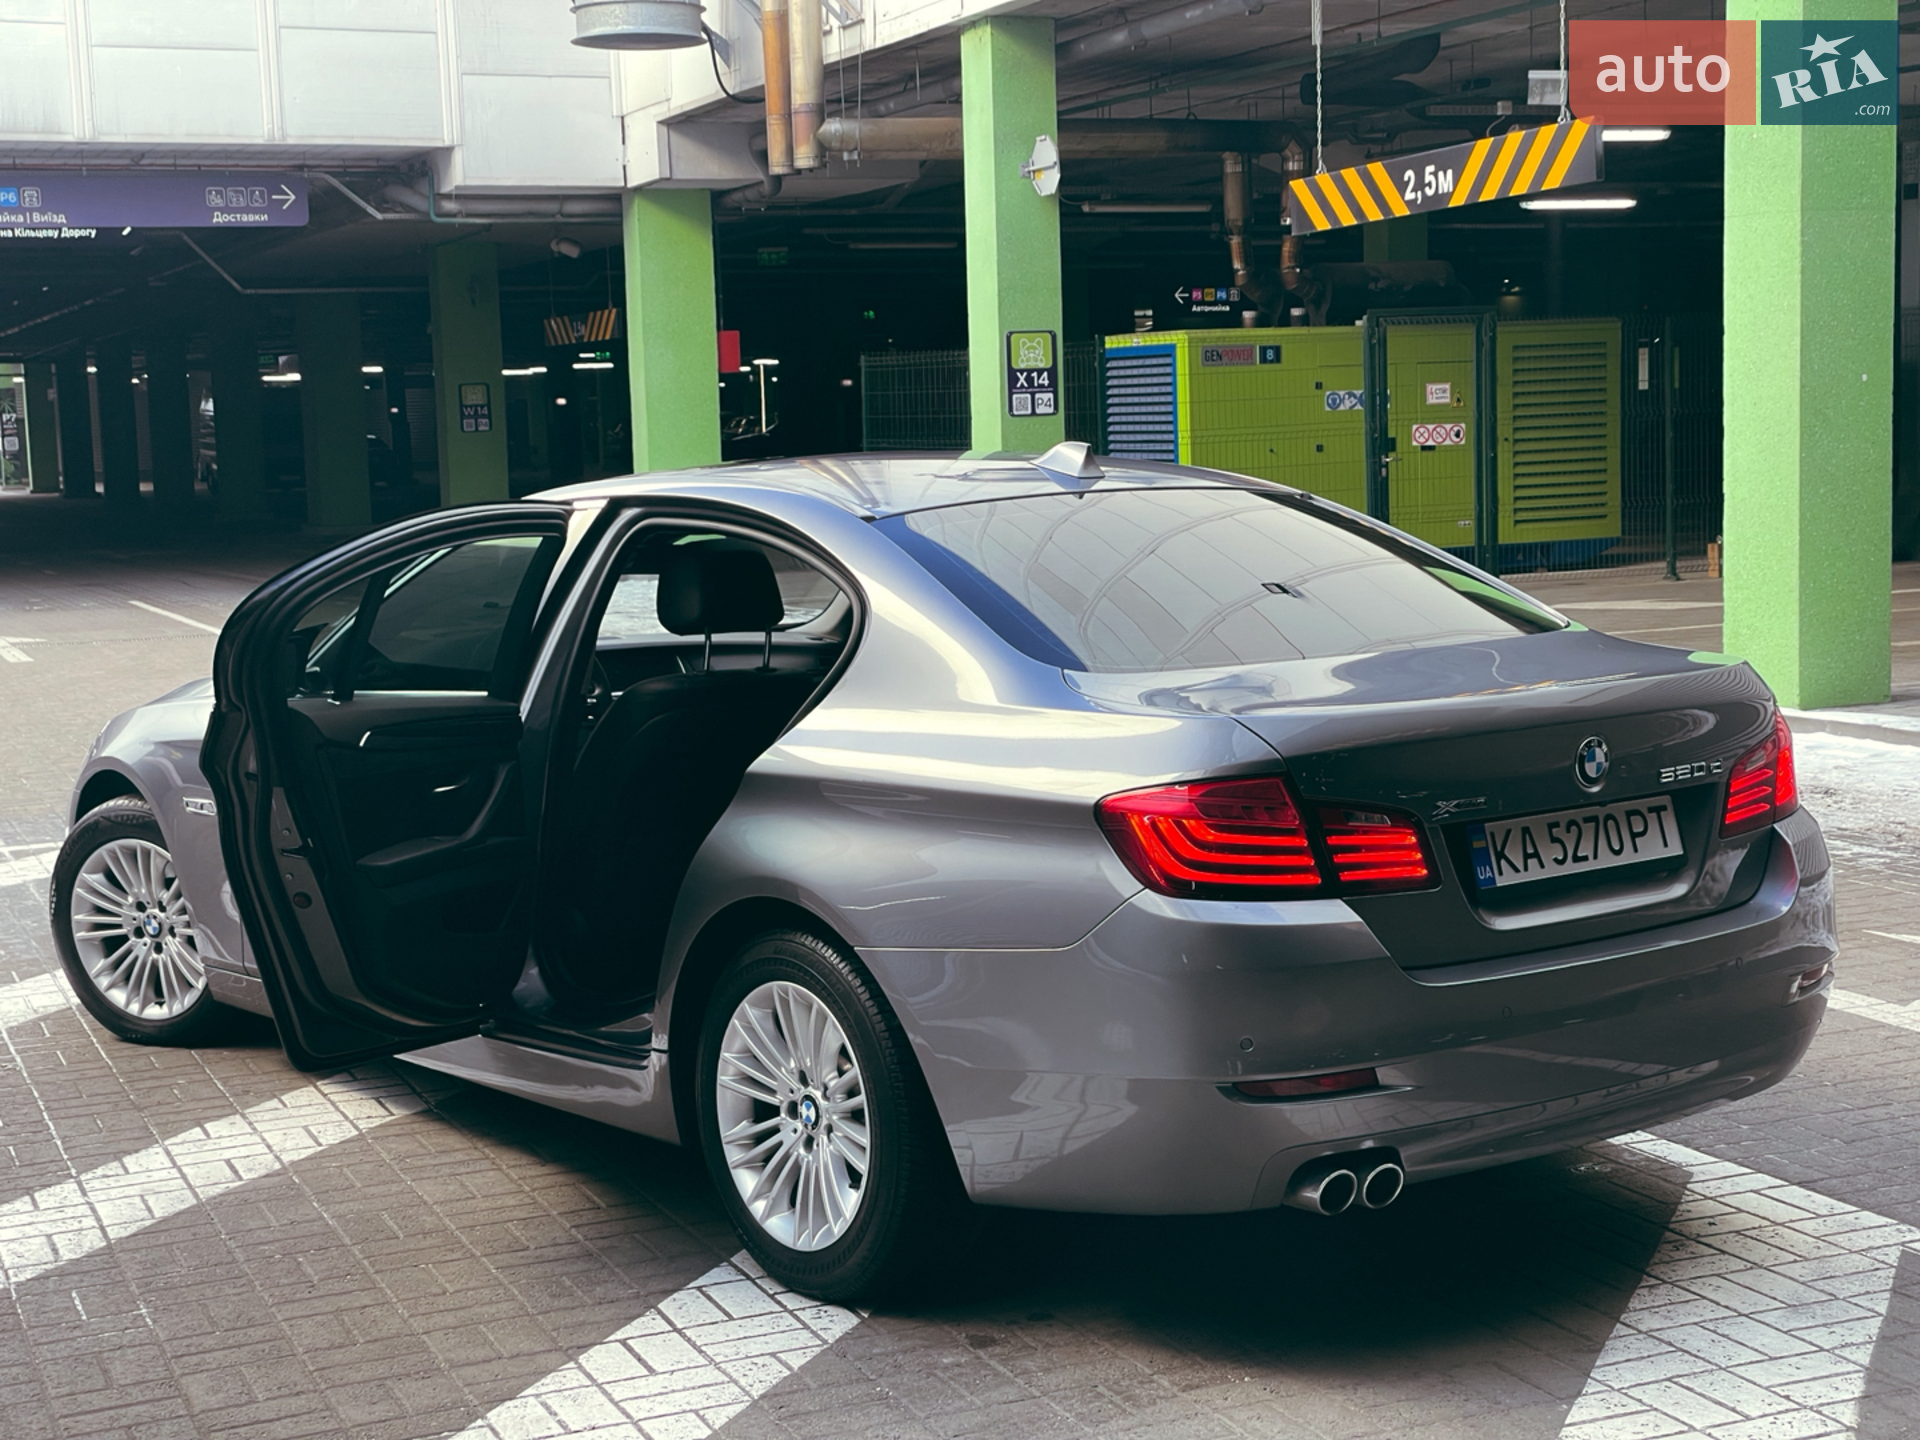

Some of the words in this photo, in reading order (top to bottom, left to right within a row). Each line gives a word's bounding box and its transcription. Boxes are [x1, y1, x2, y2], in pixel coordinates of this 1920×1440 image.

[0, 192, 17, 203] P6
[32, 212, 67, 224] Виїзд
[212, 211, 269, 223] Доставки
[14, 227, 59, 239] Кільцеву
[61, 226, 97, 239] Дорогу
[1204, 348, 1253, 362] GENPOWER
[1266, 349, 1274, 360] 8
[1016, 371, 1029, 388] X
[1031, 371, 1050, 387] 14
[1036, 397, 1052, 409] P4
[462, 406, 475, 416] W
[476, 406, 488, 416] 14
[2, 413, 17, 423] P7
[1489, 825, 1546, 876] KA
[1550, 812, 1624, 866] 5270
[1625, 804, 1670, 853] PT
[1477, 865, 1493, 879] UA
